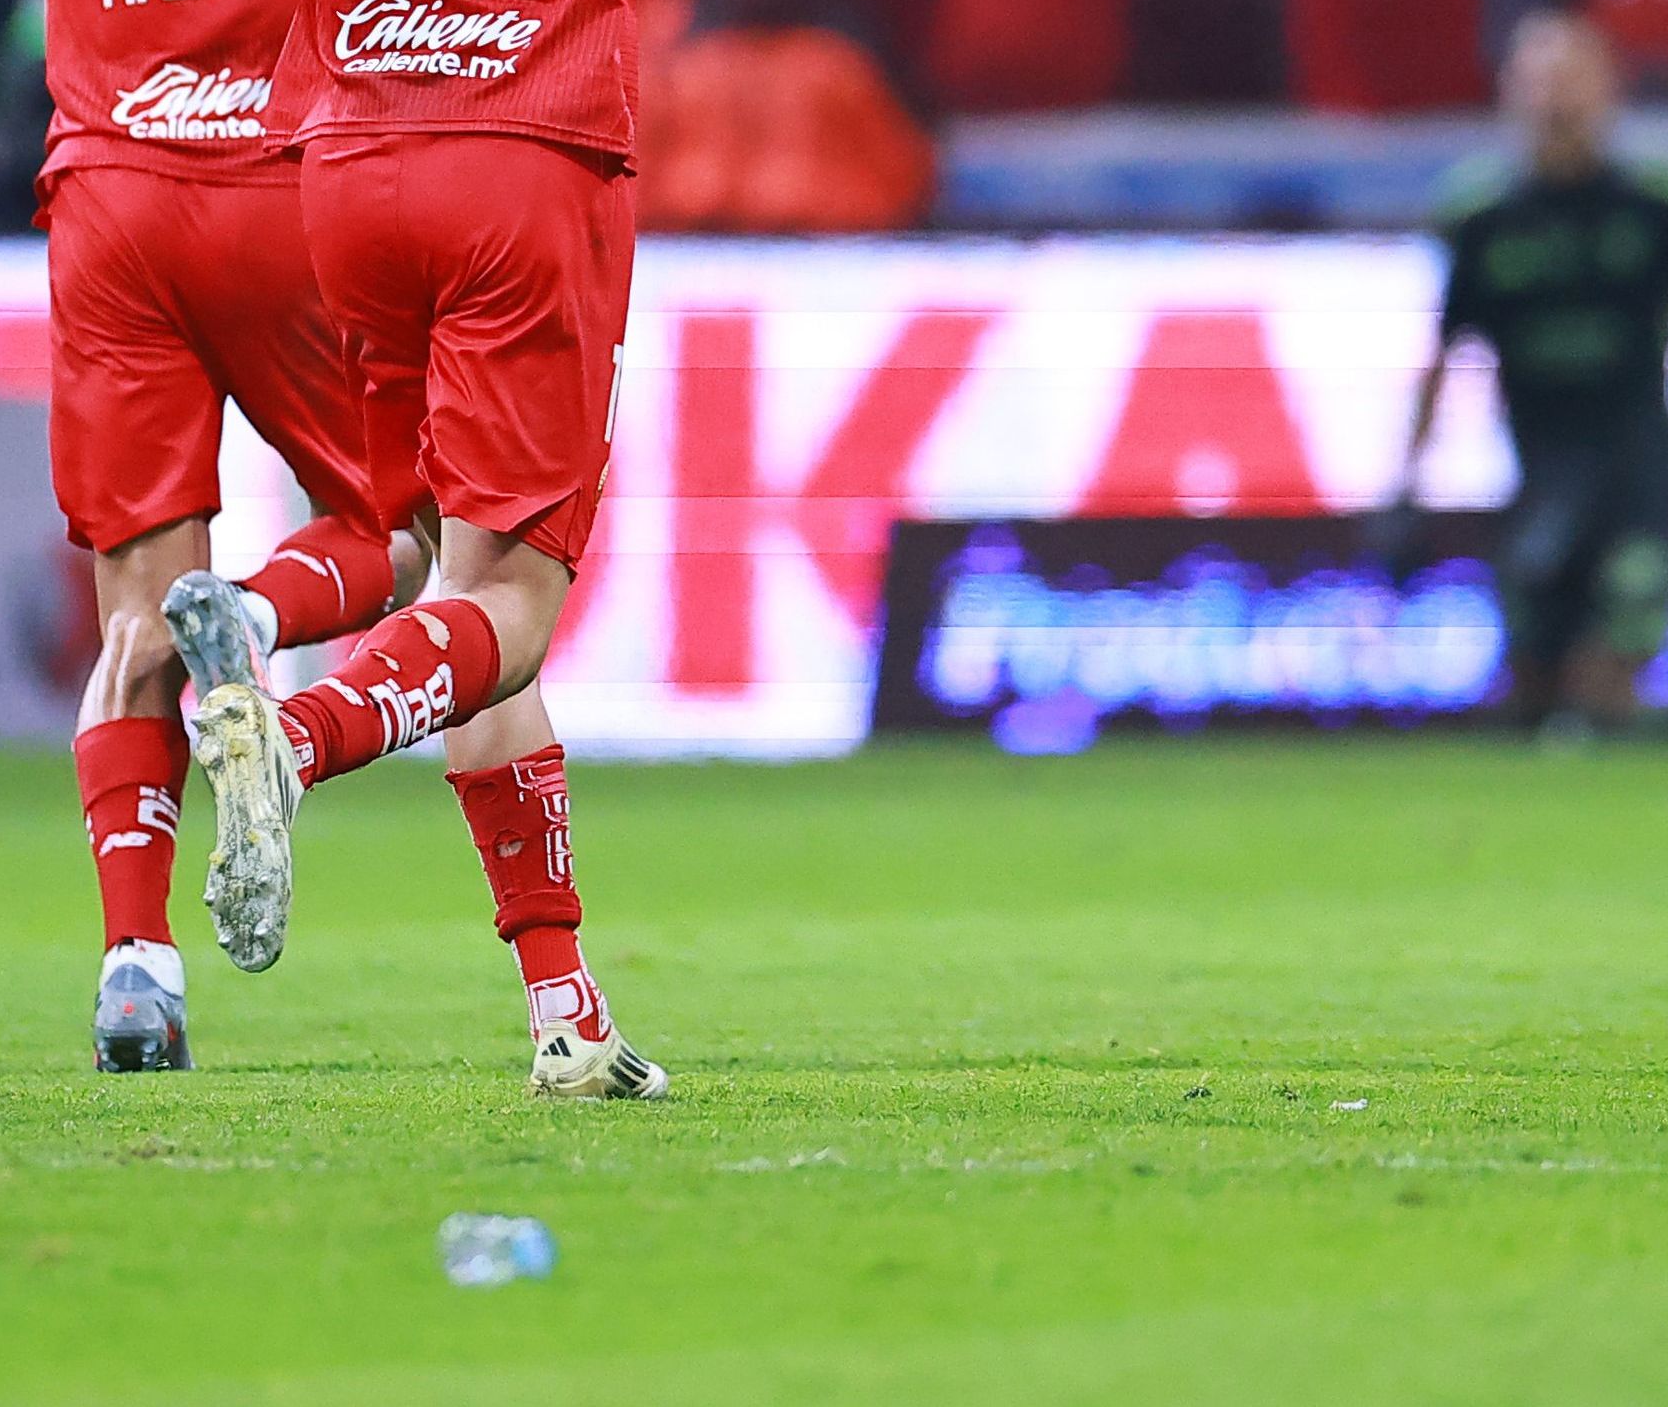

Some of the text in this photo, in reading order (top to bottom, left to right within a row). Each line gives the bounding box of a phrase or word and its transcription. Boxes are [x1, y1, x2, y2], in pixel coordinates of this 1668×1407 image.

[342, 51, 520, 80] caliente.mx
[111, 63, 275, 126] Calien
[128, 116, 267, 141] caliente.
